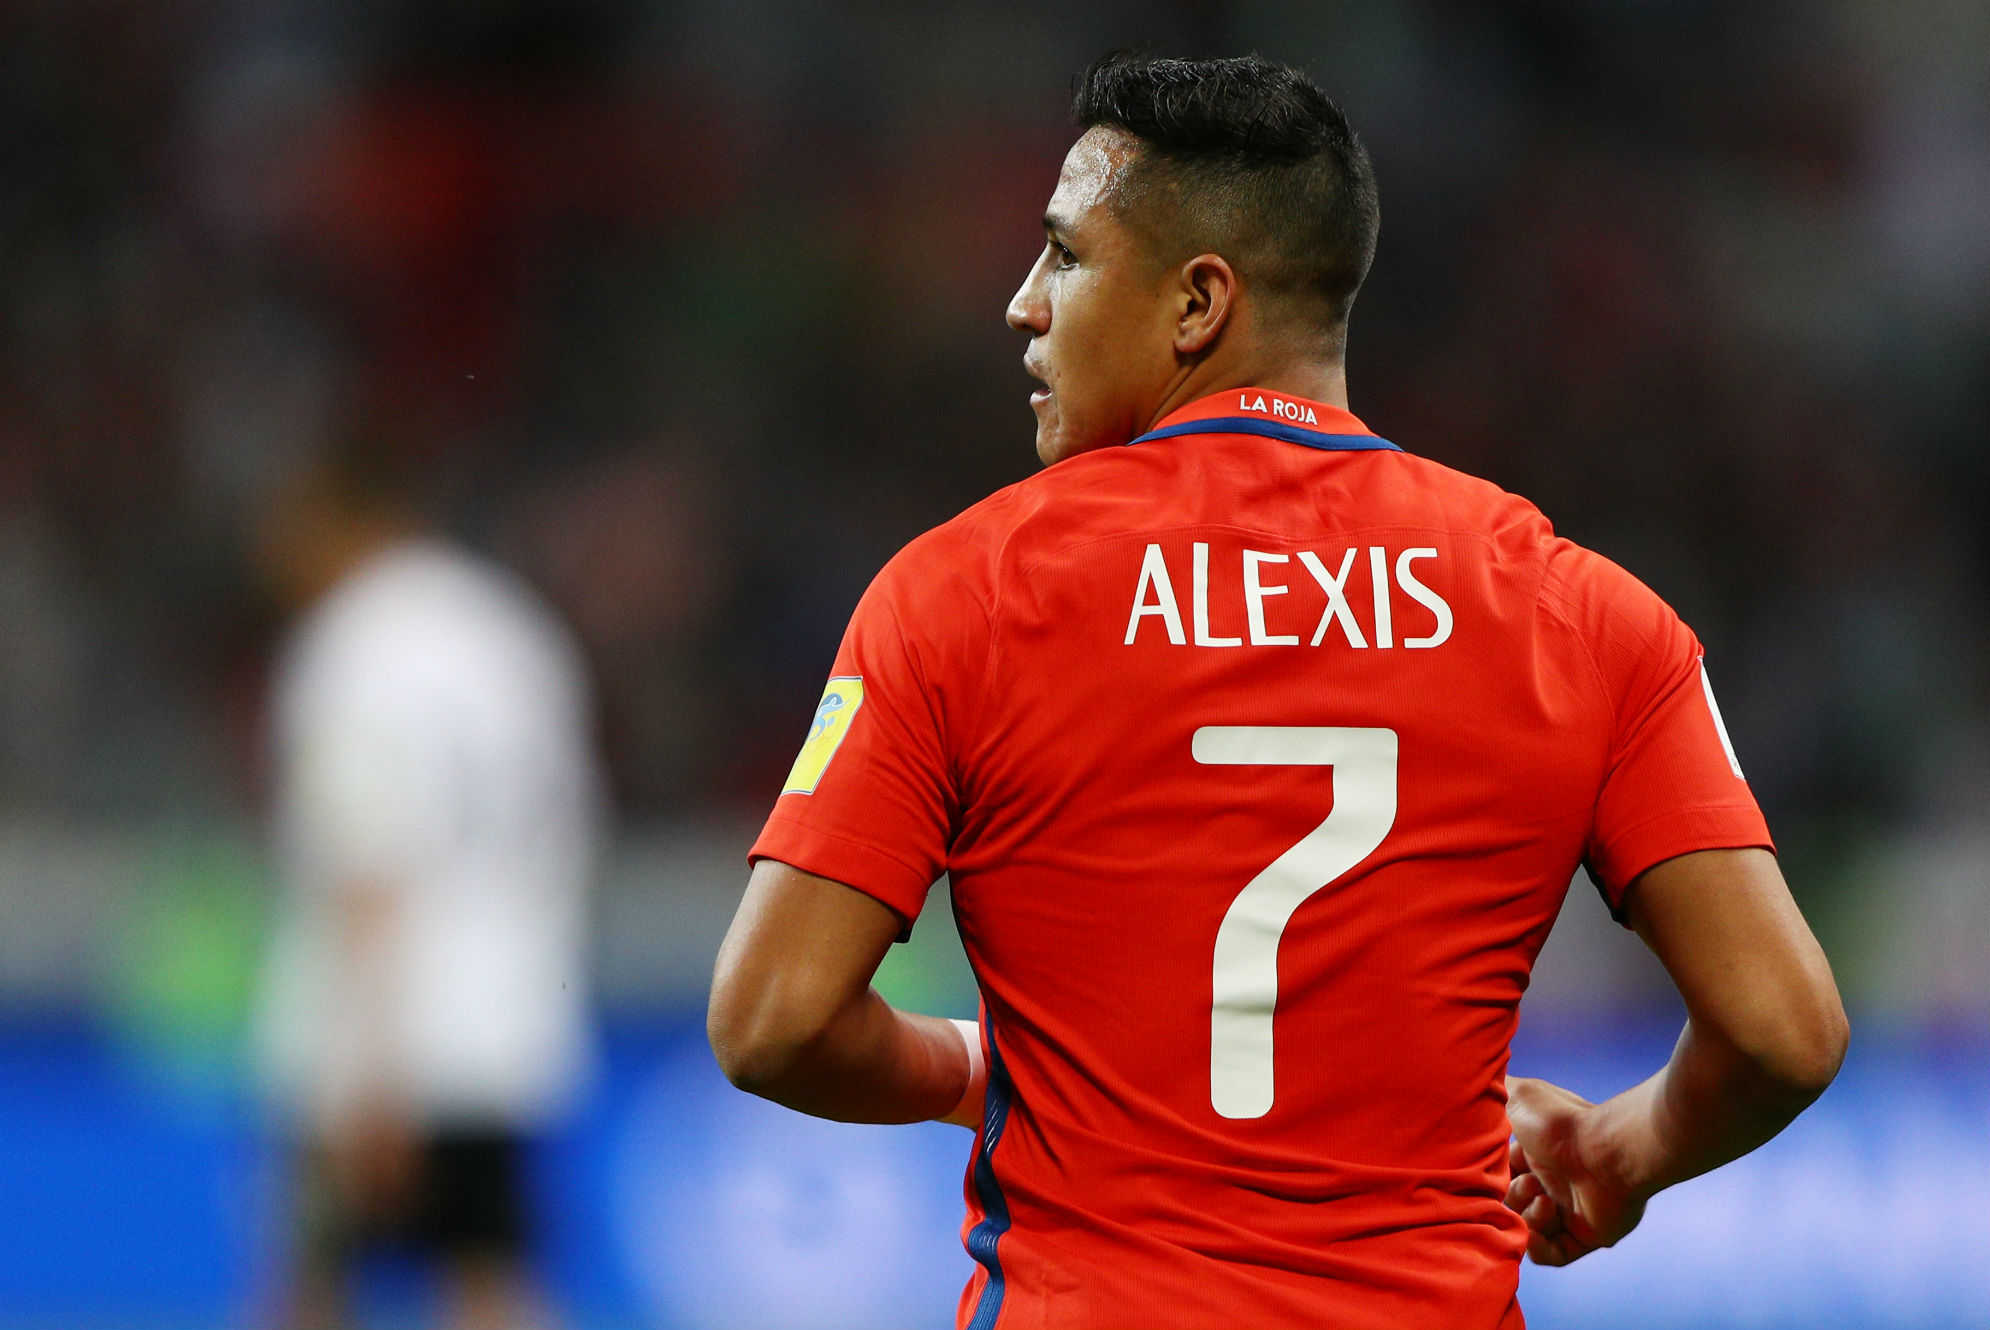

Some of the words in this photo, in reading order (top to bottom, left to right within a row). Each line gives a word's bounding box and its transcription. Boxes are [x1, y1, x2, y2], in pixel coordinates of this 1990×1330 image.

[1239, 394, 1268, 413] LA
[1273, 398, 1318, 425] ROJA
[1123, 541, 1454, 649] ALEXIS
[1191, 726, 1399, 1120] 7
